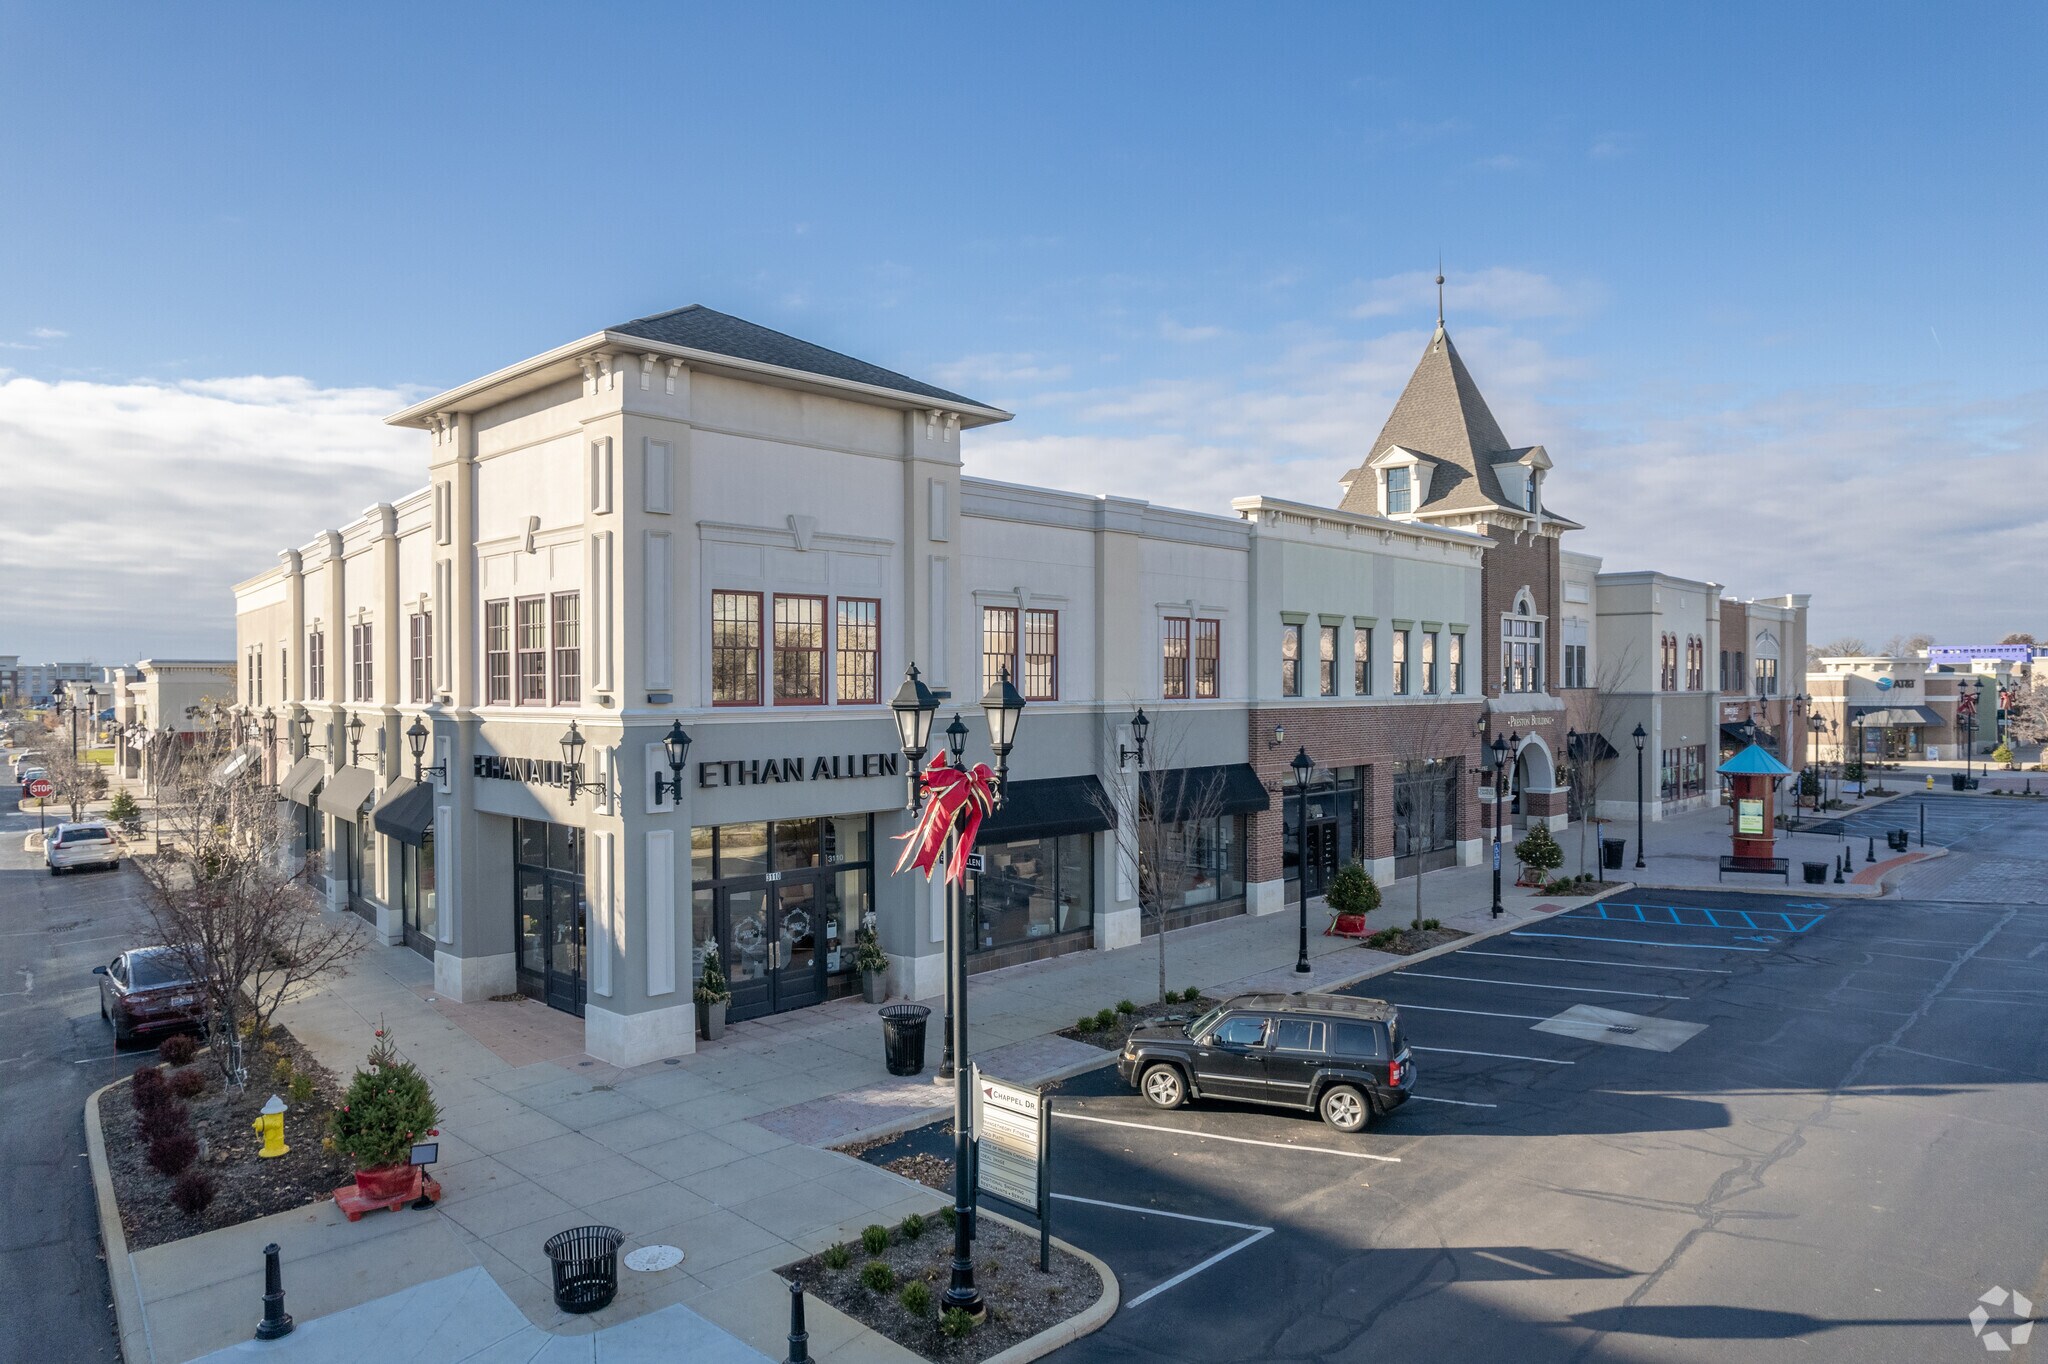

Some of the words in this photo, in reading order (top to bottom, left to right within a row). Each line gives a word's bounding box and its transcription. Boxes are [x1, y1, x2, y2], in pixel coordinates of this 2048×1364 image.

[1510, 716, 1530, 728] PRESTON
[1531, 714, 1552, 726] BUILDING
[474, 755, 527, 783] ETHAN
[699, 757, 804, 788] ETHAN
[811, 753, 899, 781] ALLEN
[32, 784, 52, 792] STOP
[828, 854, 844, 862] 3110
[966, 858, 980, 867] LEN
[766, 872, 782, 882] 3110
[993, 1090, 1023, 1106] CHAPPEL
[984, 1120, 1012, 1132] RANGETHEORY
